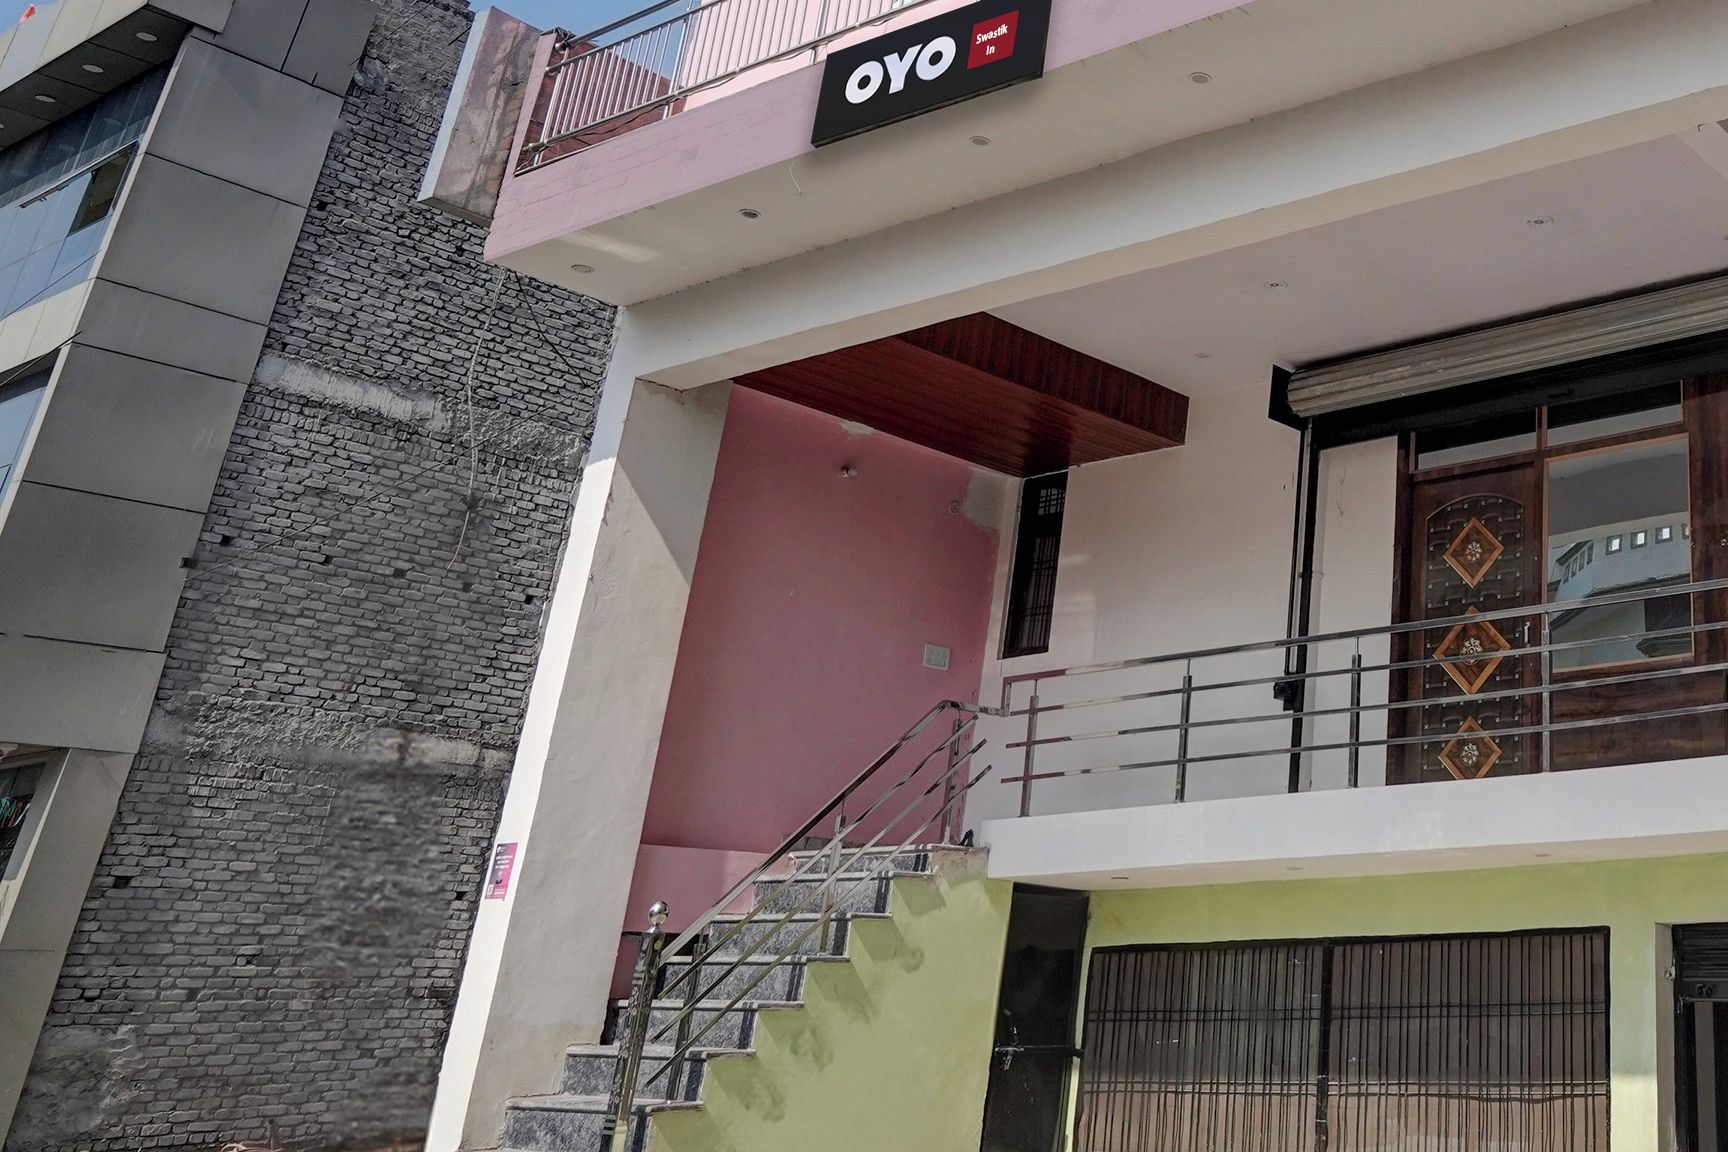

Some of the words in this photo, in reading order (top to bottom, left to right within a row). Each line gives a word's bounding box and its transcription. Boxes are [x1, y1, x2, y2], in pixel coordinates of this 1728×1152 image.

[975, 23, 1008, 45] Swastik
[985, 44, 996, 56] In
[845, 35, 957, 104] OYO
